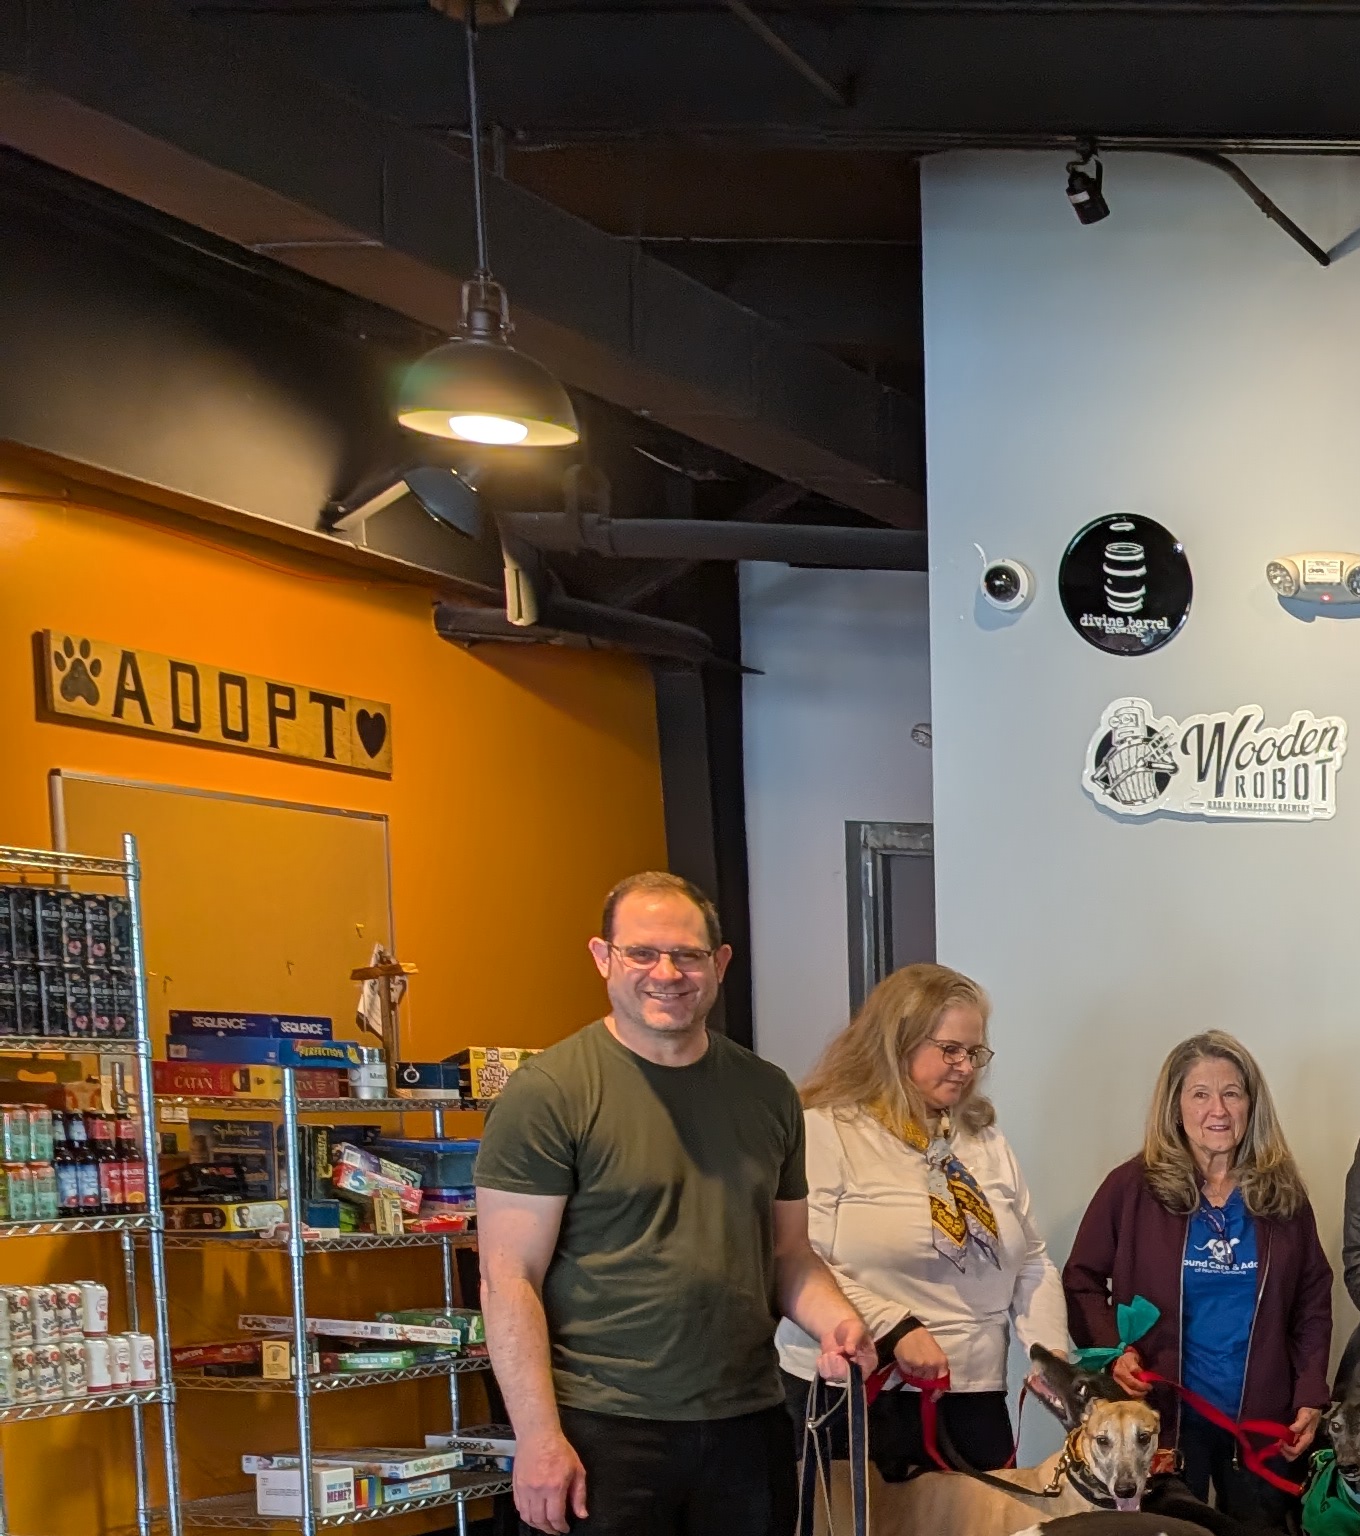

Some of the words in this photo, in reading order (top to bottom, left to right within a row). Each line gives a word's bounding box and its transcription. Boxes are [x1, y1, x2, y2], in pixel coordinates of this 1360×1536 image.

[1079, 613, 1125, 628] divine
[1127, 615, 1172, 632] barrel
[110, 650, 347, 761] ADOPT
[1180, 713, 1340, 799] Wooden
[1235, 757, 1334, 802] ROBOT
[192, 1016, 247, 1030] SEQUENCE
[280, 1021, 324, 1035] SEQUENCE
